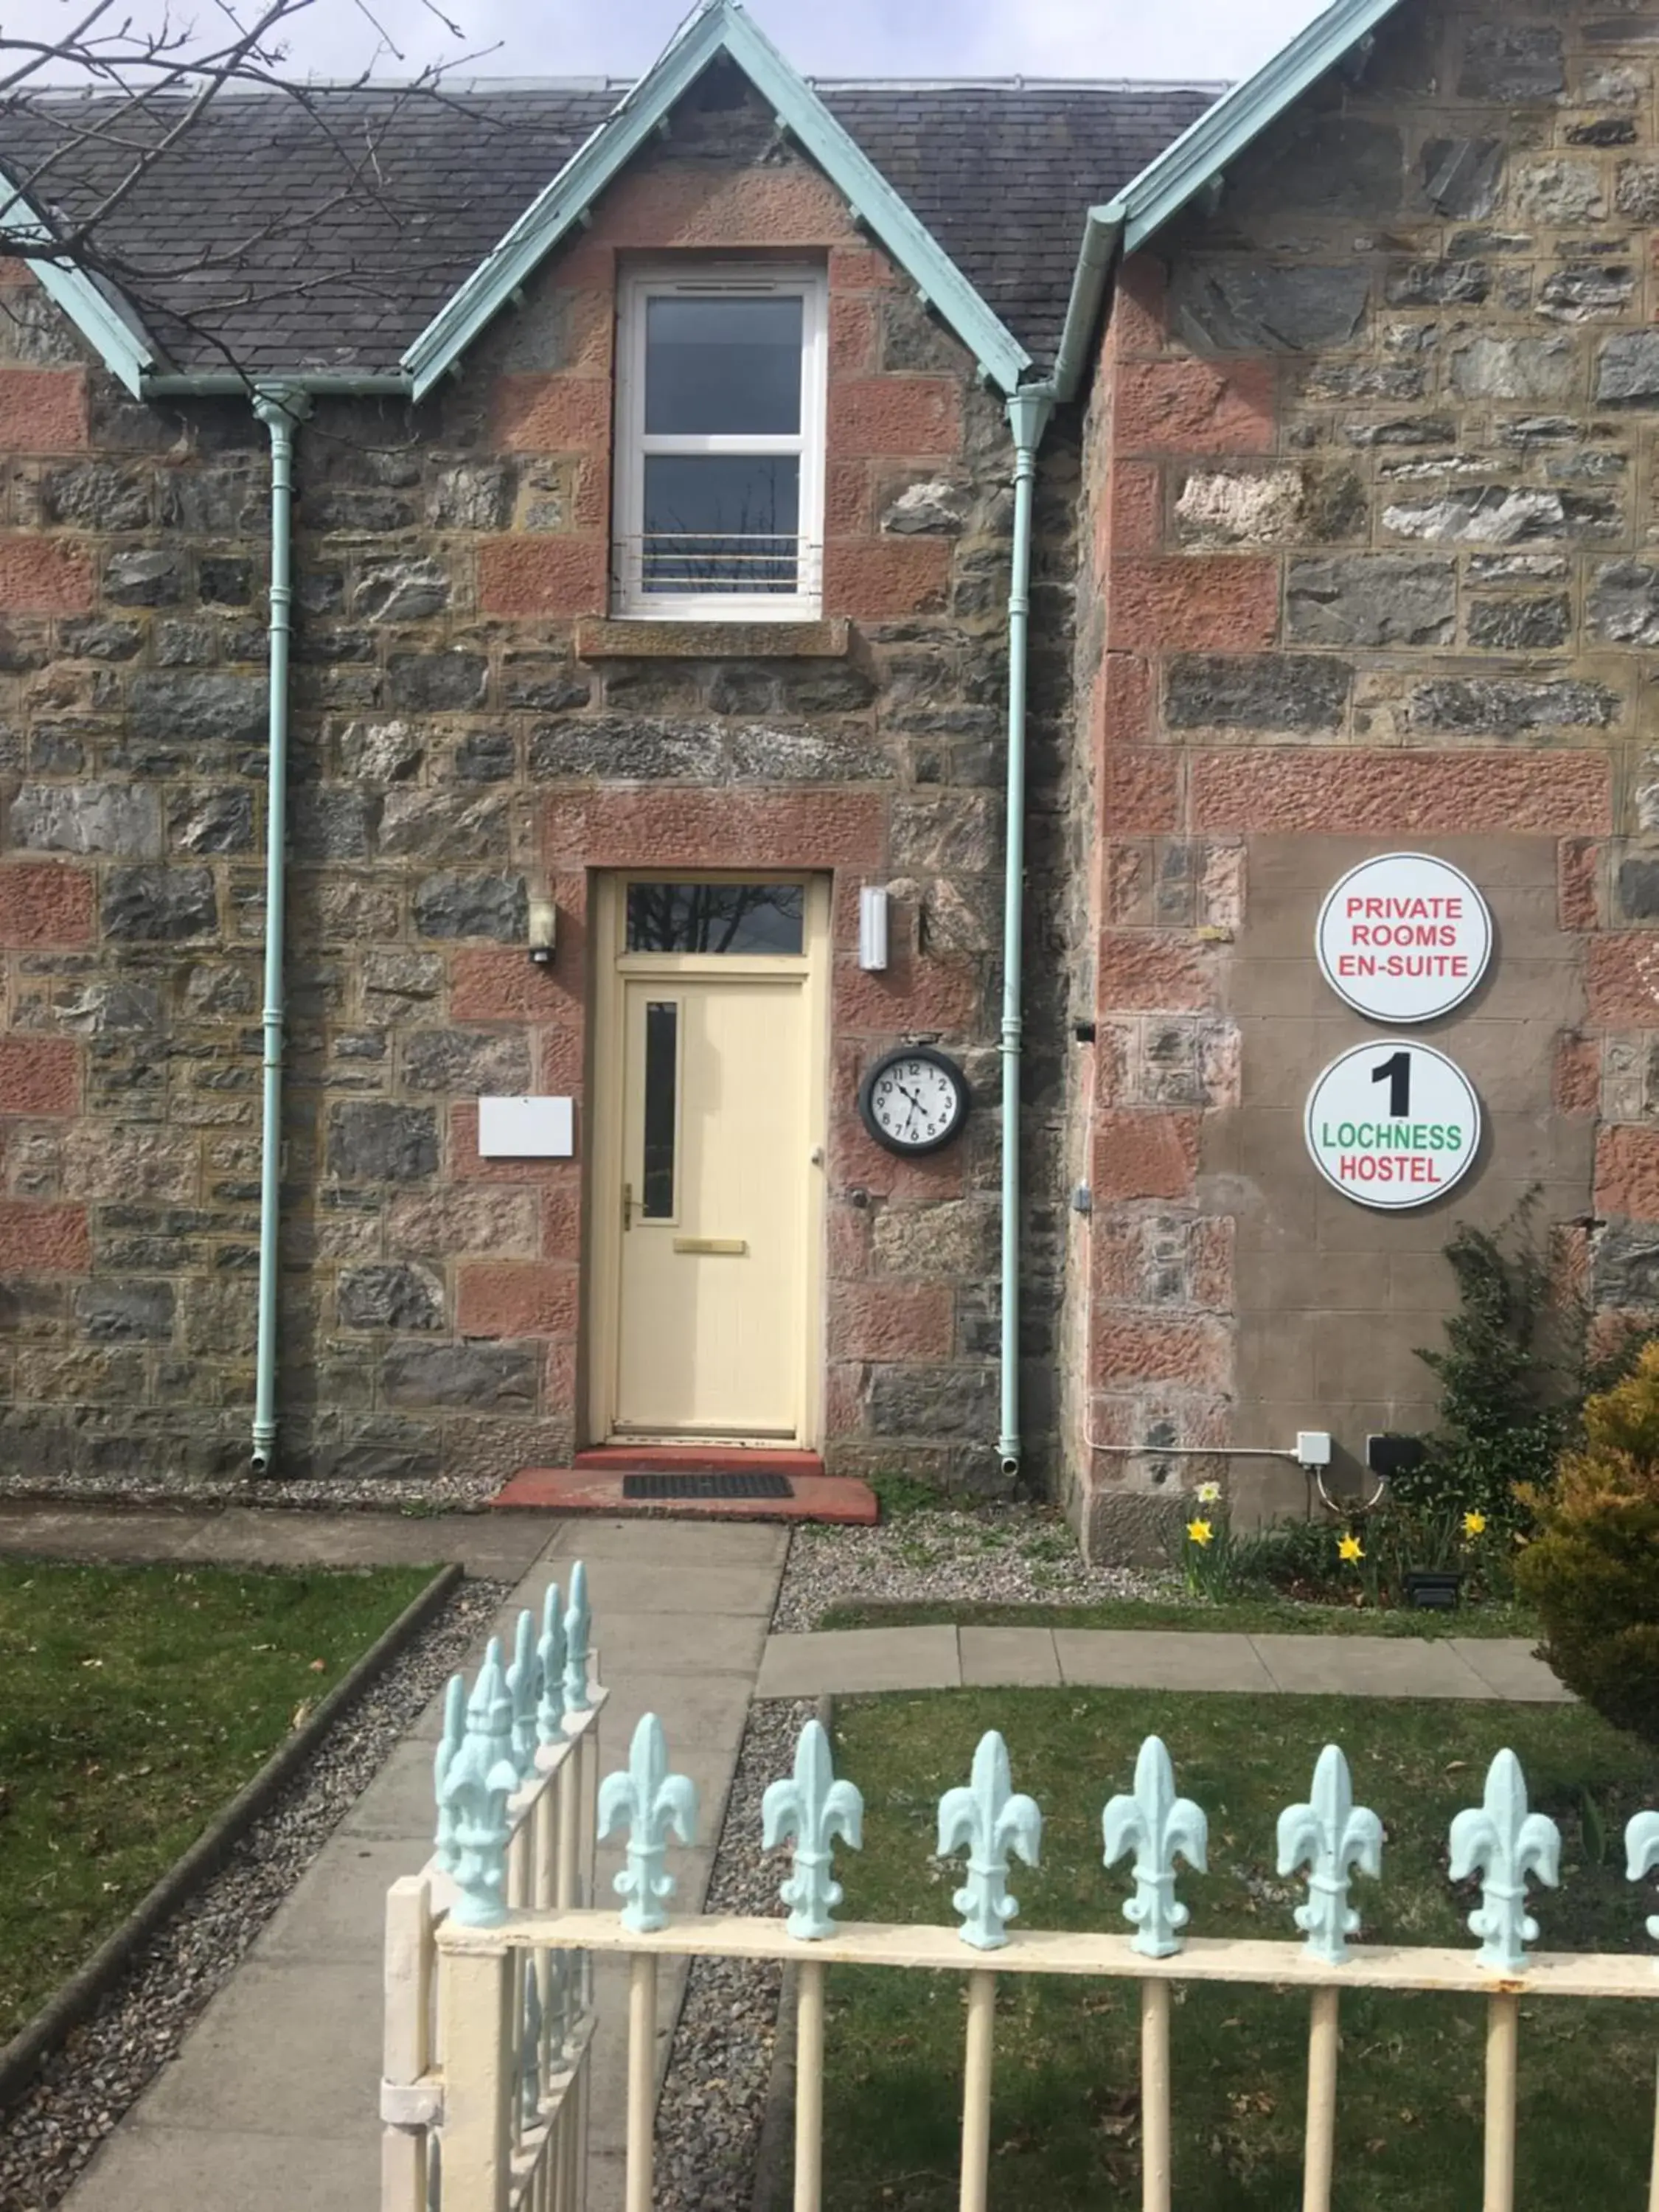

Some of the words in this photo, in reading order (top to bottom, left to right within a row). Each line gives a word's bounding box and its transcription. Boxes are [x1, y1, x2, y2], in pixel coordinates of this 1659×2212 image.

[1346, 897, 1463, 919] PRIVATE
[1352, 925, 1456, 947] ROOMS
[1338, 955, 1468, 977] EN-SUITE
[893, 1068, 903, 1080] 11
[908, 1063, 920, 1076] 12
[881, 1081, 893, 1093] 10
[939, 1079, 947, 1091] 2
[1371, 1052, 1411, 1118] 1
[877, 1097, 885, 1108] 9
[945, 1096, 953, 1109] 3
[882, 1113, 891, 1125] 8
[939, 1113, 947, 1124] 4
[895, 1124, 903, 1136] 7
[911, 1128, 919, 1141] 6
[927, 1123, 936, 1135] 5
[1323, 1122, 1462, 1150] LOCHNESS
[1340, 1155, 1441, 1183] HOSTEL
